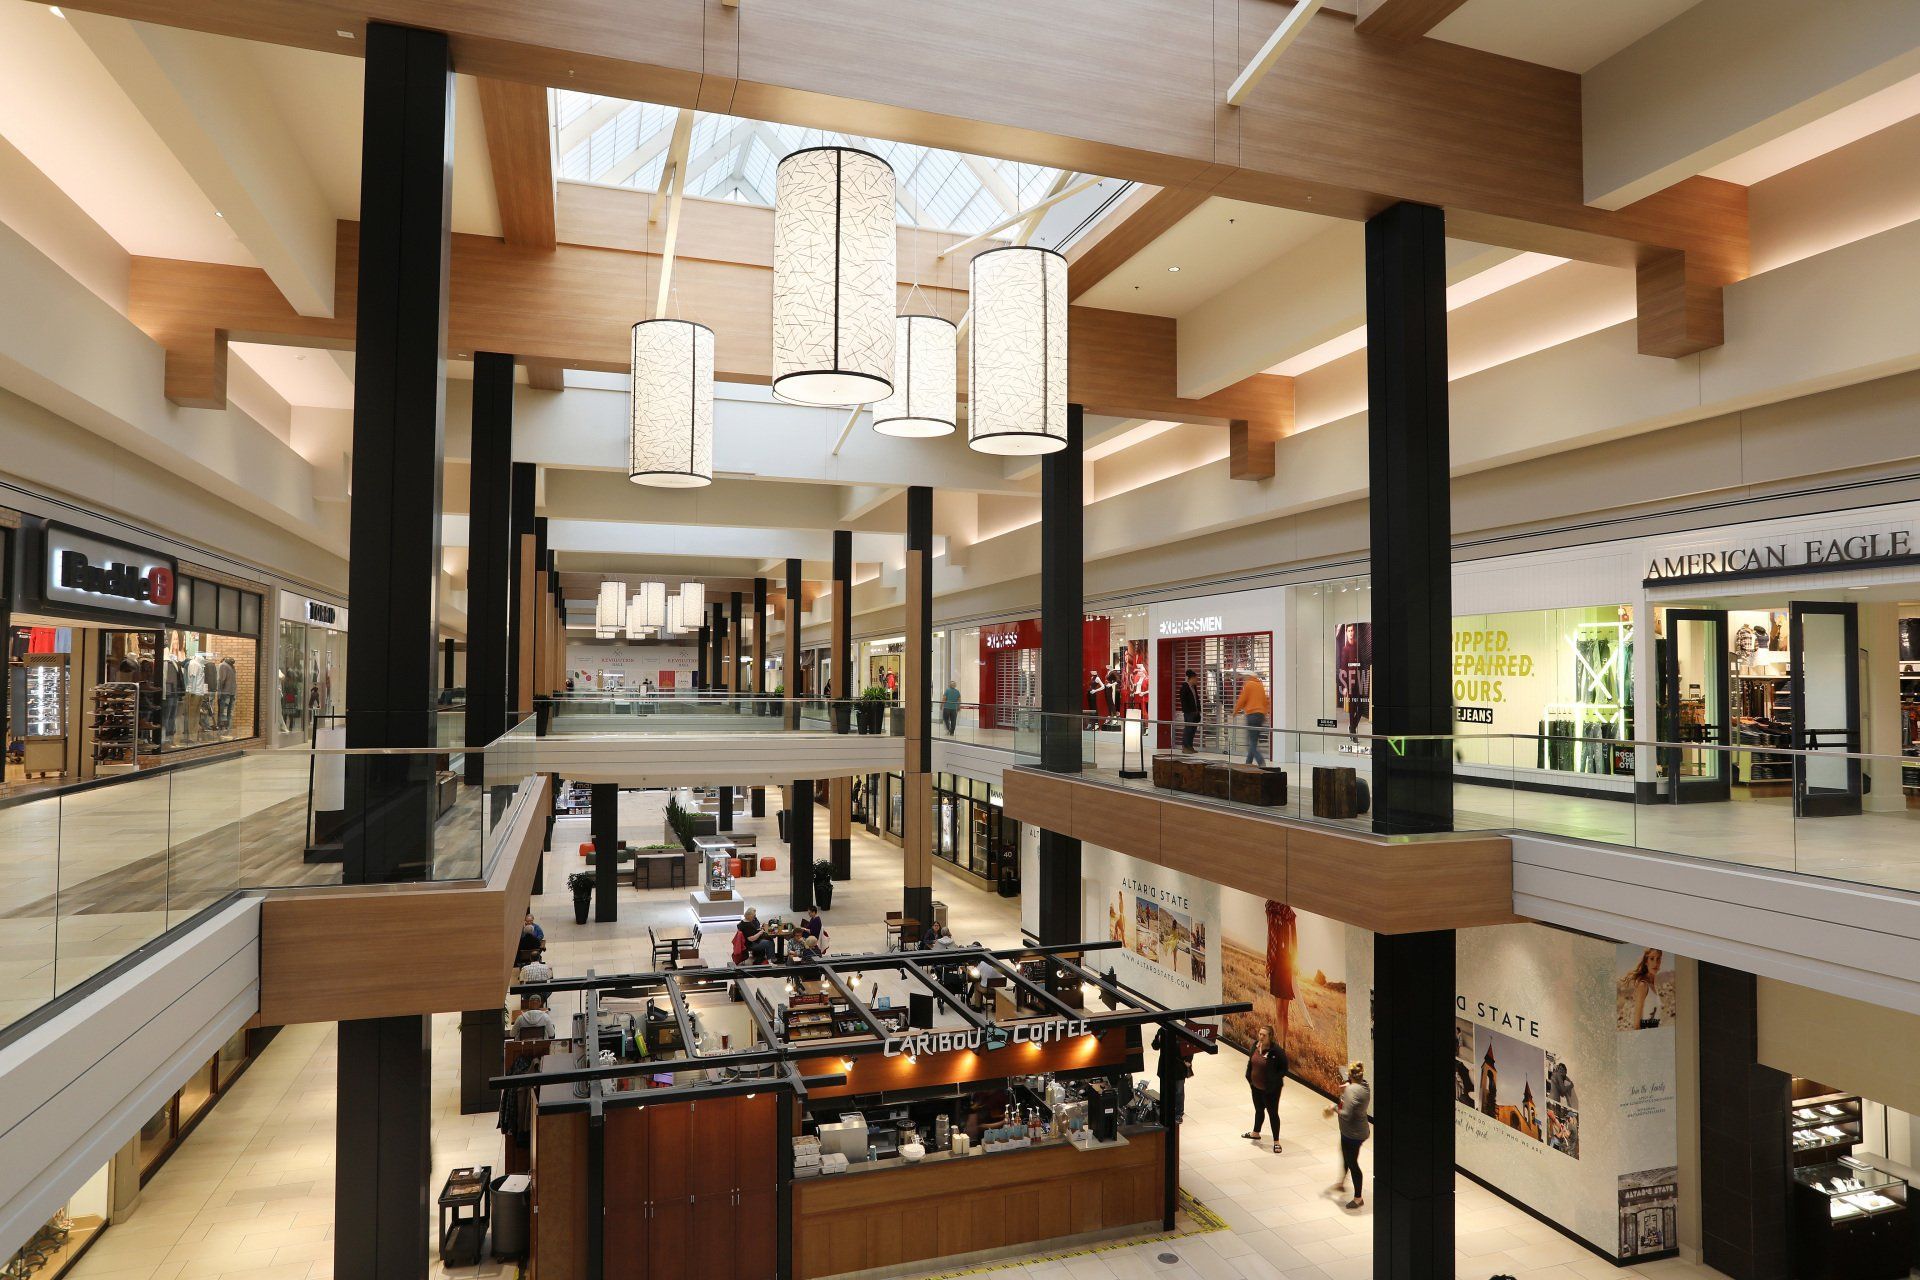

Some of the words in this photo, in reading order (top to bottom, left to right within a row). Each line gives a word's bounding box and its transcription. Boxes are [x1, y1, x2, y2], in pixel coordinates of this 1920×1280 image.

[1647, 543, 1787, 579] AMERICAN
[1804, 530, 1912, 564] EAGLE
[986, 631, 1018, 649] EXPRESS
[1454, 630, 1511, 653] IPPED.
[1453, 654, 1535, 677] EPAIRED.
[1453, 679, 1507, 703] OURS.
[1456, 708, 1492, 723] EJEANS
[1160, 889, 1189, 910] STATE
[1477, 1002, 1539, 1038] STATE
[883, 1026, 981, 1058] CARIBOU
[1013, 1019, 1093, 1043] COFFEE
